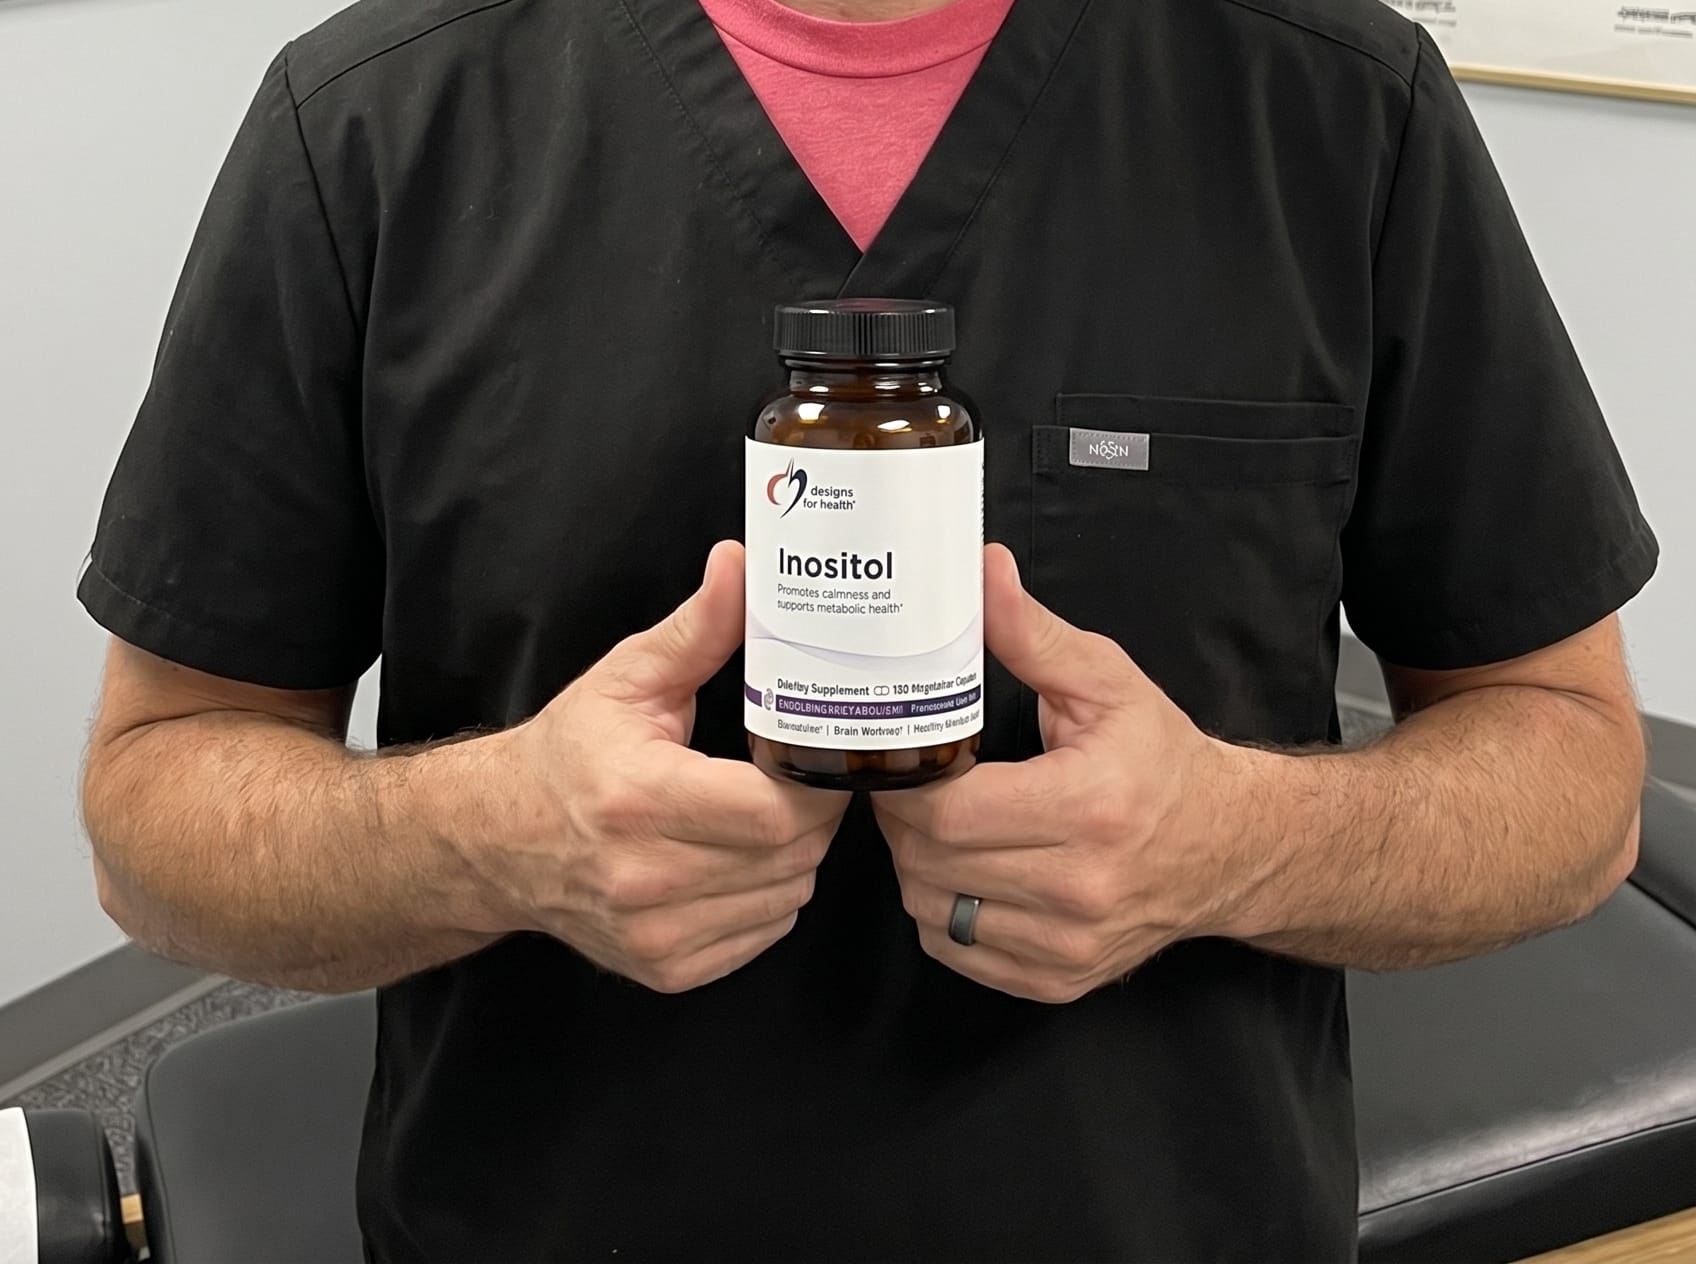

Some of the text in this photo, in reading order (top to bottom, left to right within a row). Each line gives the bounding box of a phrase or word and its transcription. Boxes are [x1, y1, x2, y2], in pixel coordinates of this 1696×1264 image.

[810, 485, 854, 499] designs
[803, 498, 818, 508] for
[779, 547, 893, 579] Inositol
[777, 583, 891, 600] Promotes calmness and
[817, 602, 866, 614] metabolic
[811, 683, 869, 697] Supplement
[834, 726, 858, 736] Brain
